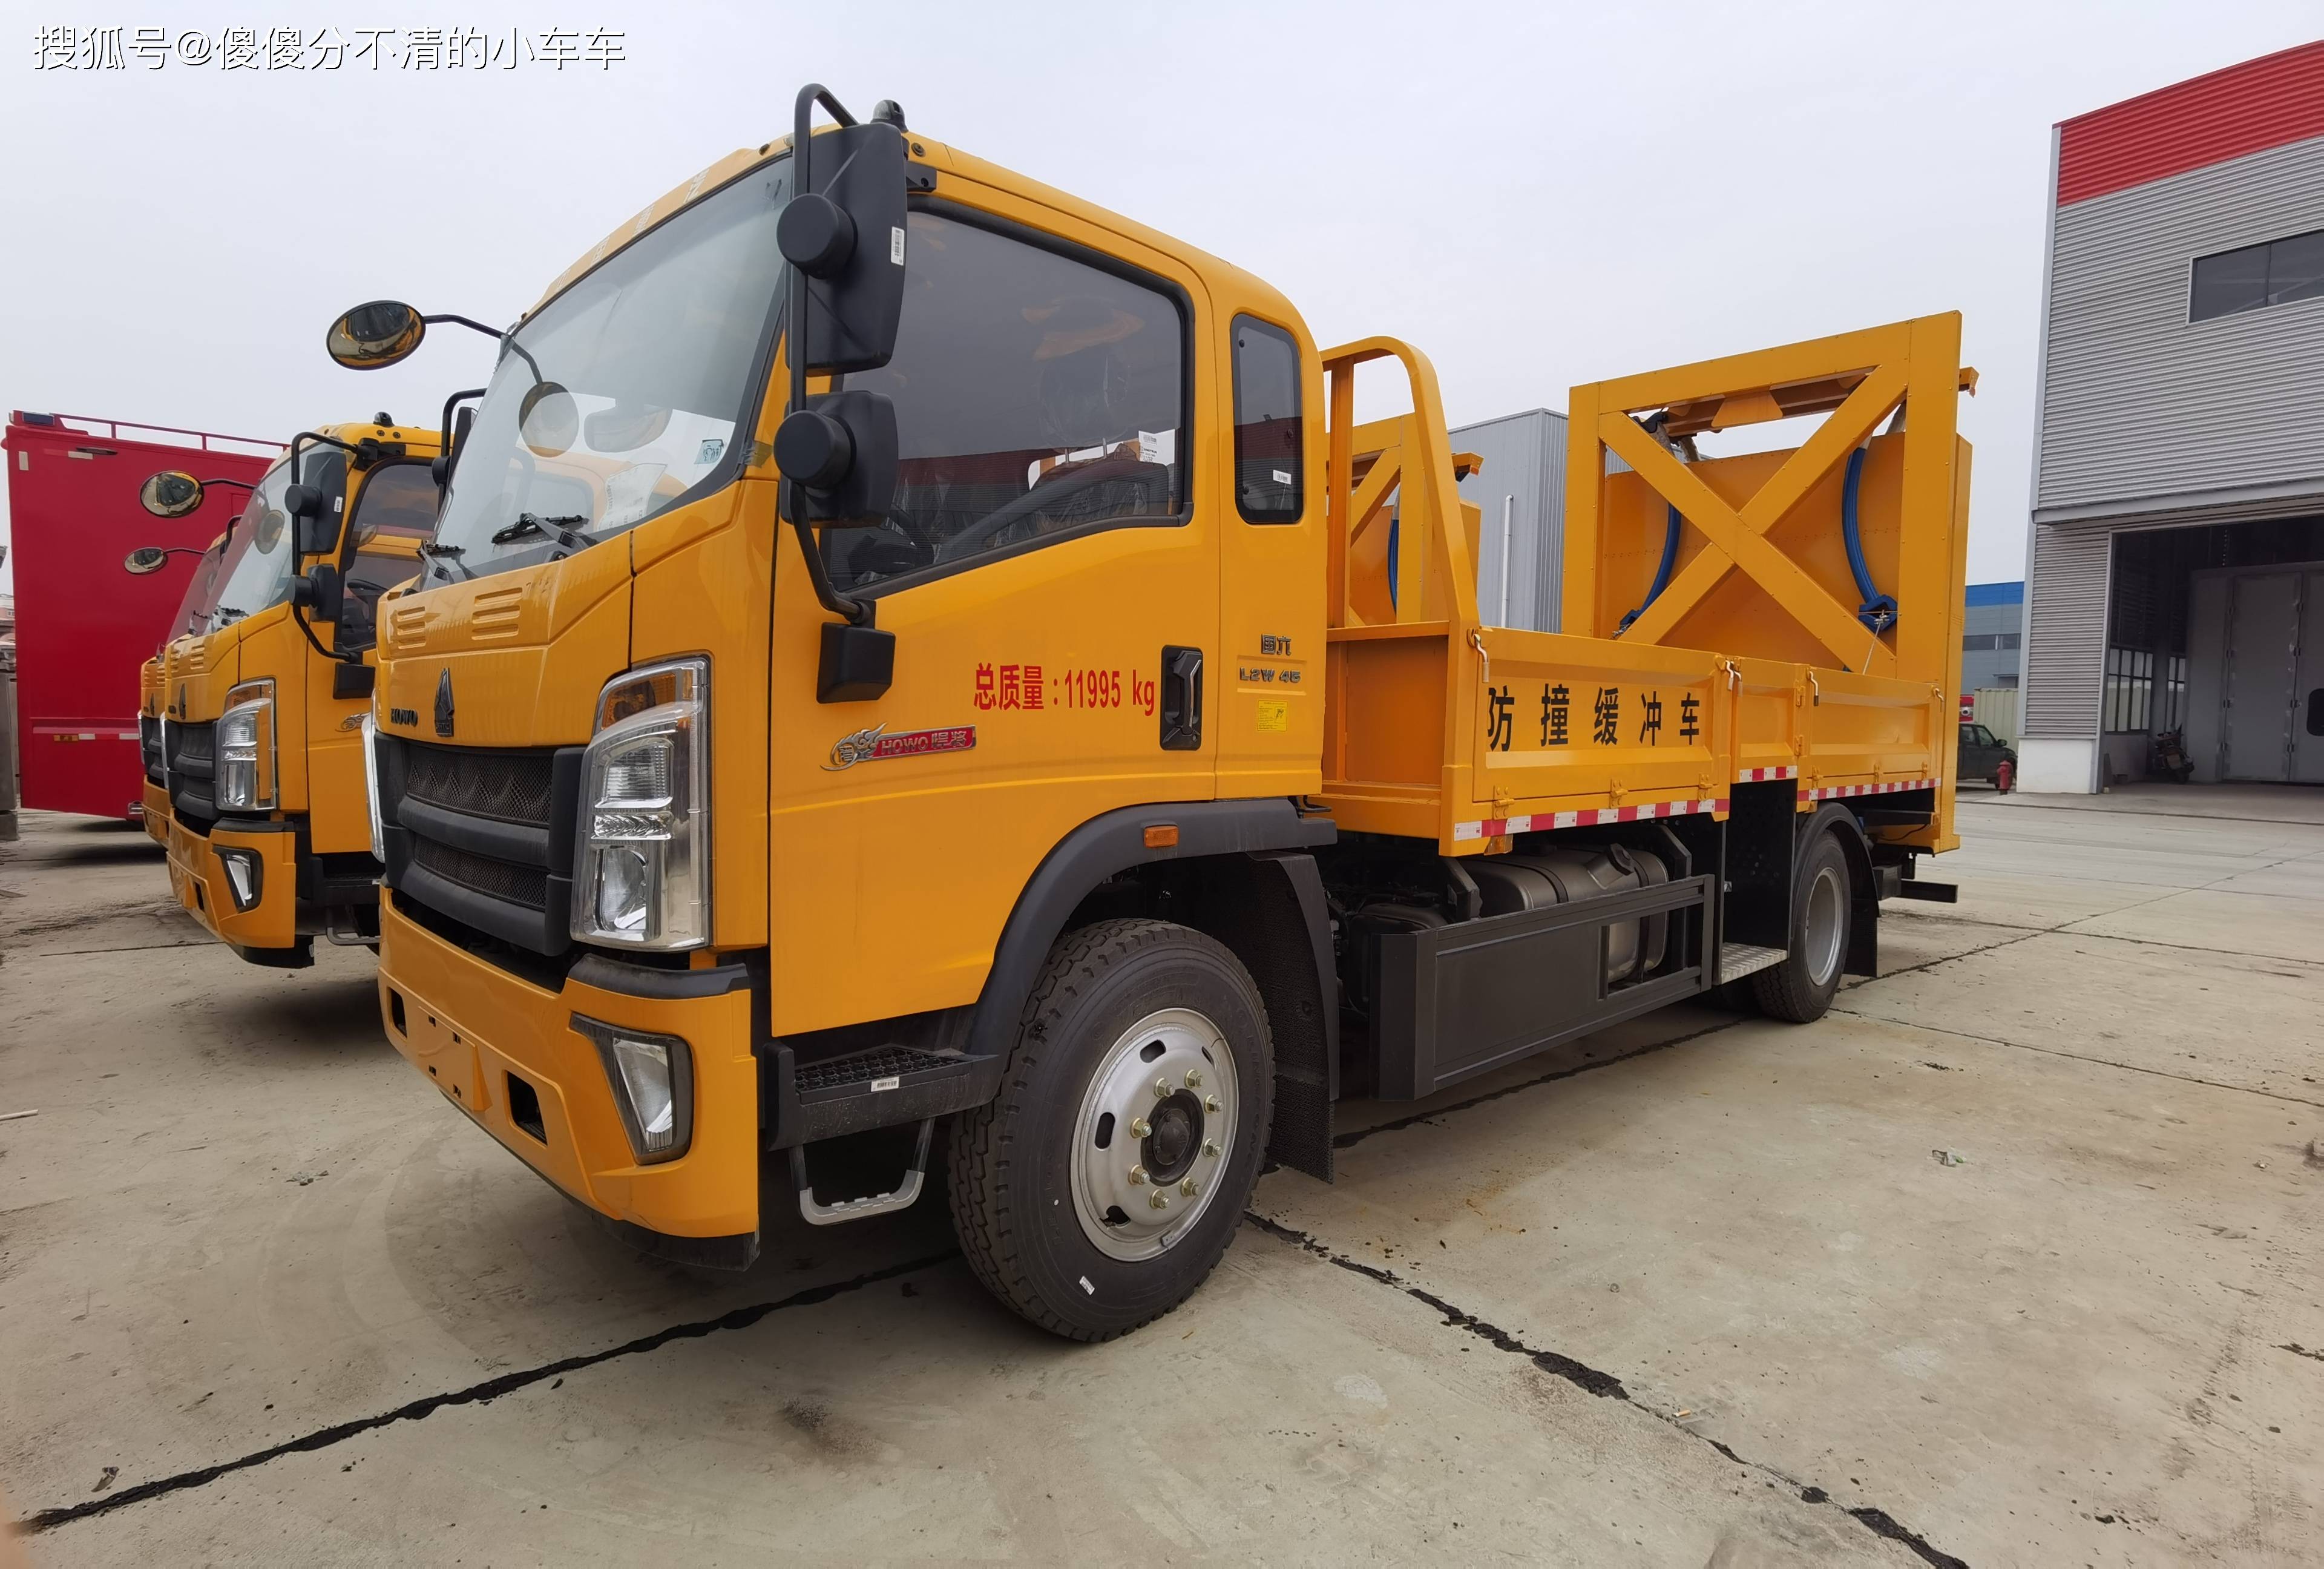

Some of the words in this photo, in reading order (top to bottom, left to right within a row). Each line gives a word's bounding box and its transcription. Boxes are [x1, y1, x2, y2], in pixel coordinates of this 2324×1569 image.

[1261, 634, 1292, 656] 国六
[1240, 667, 1275, 682] L2W
[1132, 669, 1155, 716] kg
[1488, 683, 1699, 752] 防撞缓冲车
[881, 736, 928, 756] HOWO
